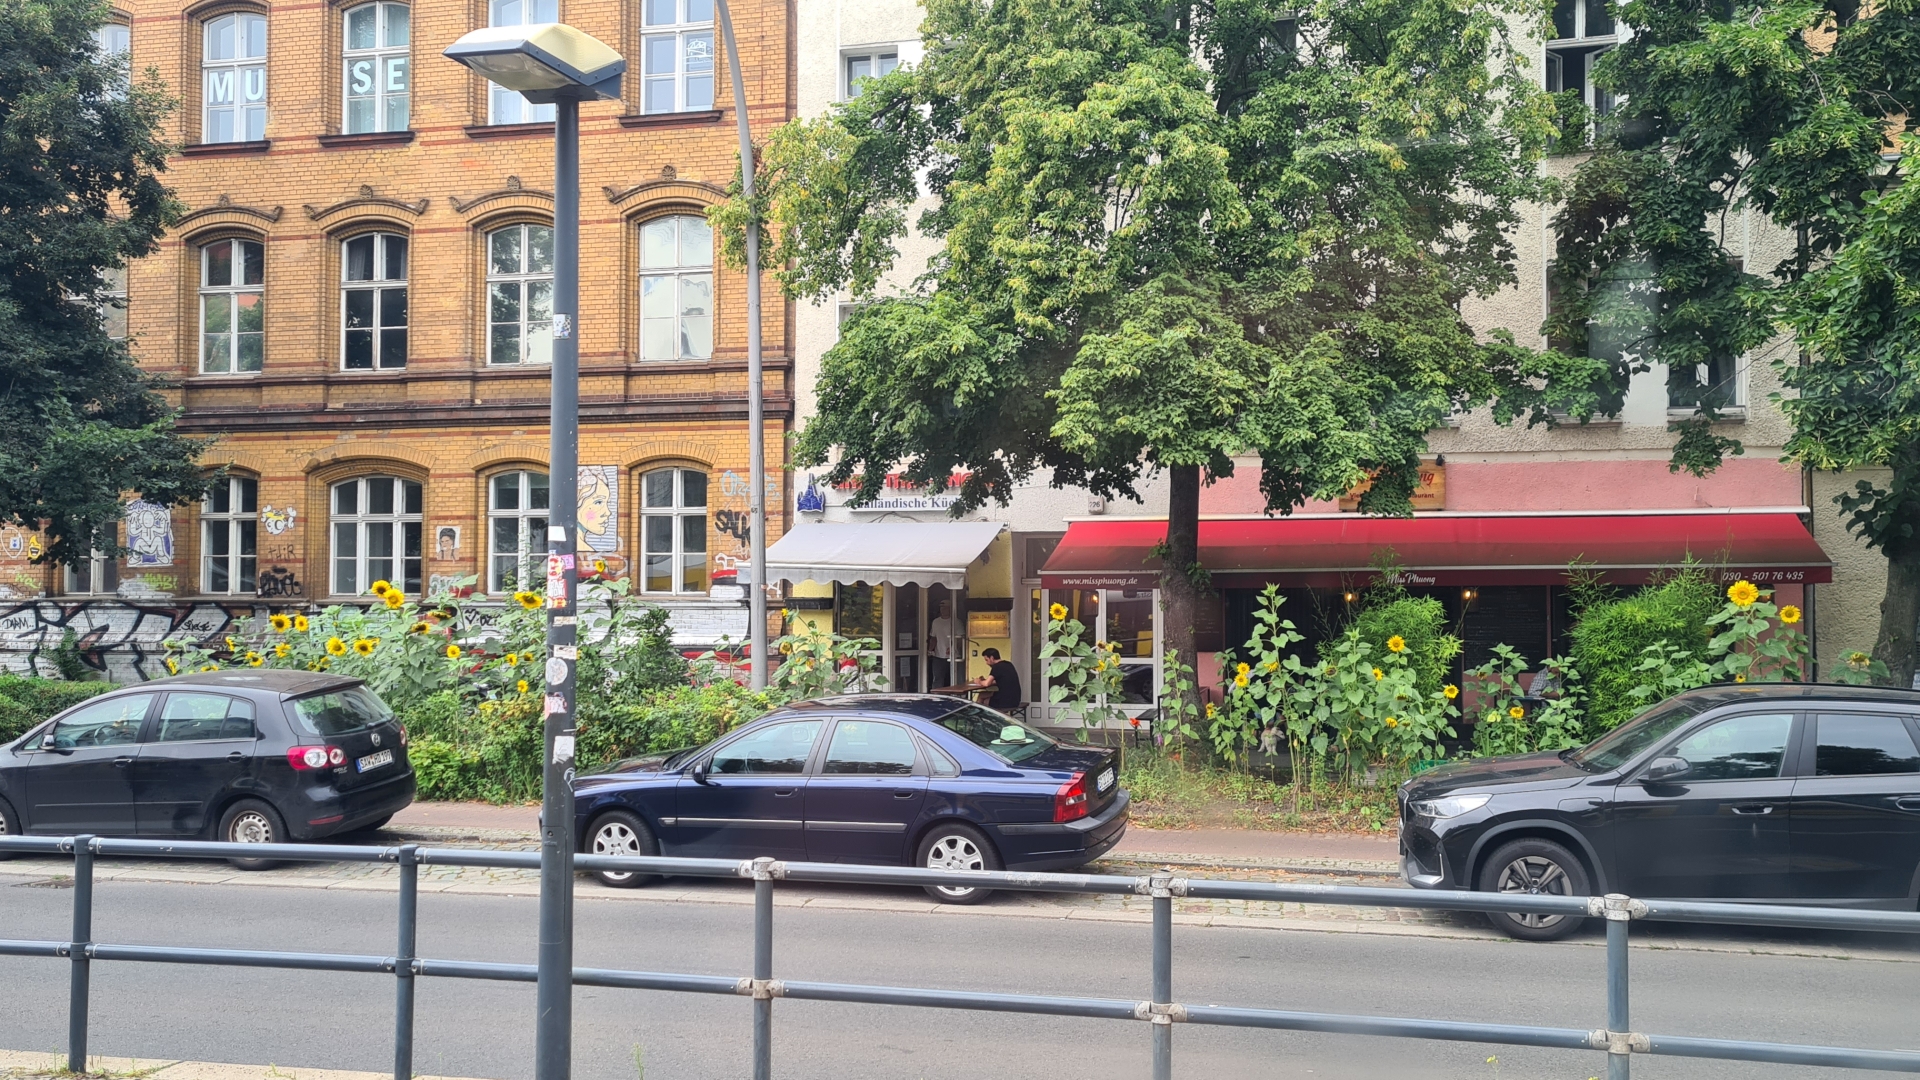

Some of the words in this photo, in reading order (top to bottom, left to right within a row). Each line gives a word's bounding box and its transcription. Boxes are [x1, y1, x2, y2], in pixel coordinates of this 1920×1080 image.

[1722, 572, 1742, 581] 030
[1752, 572, 1770, 580] 501
[1772, 572, 1784, 580] 76
[1786, 571, 1805, 580] 435
[1062, 577, 1138, 588] www.missphuong.de
